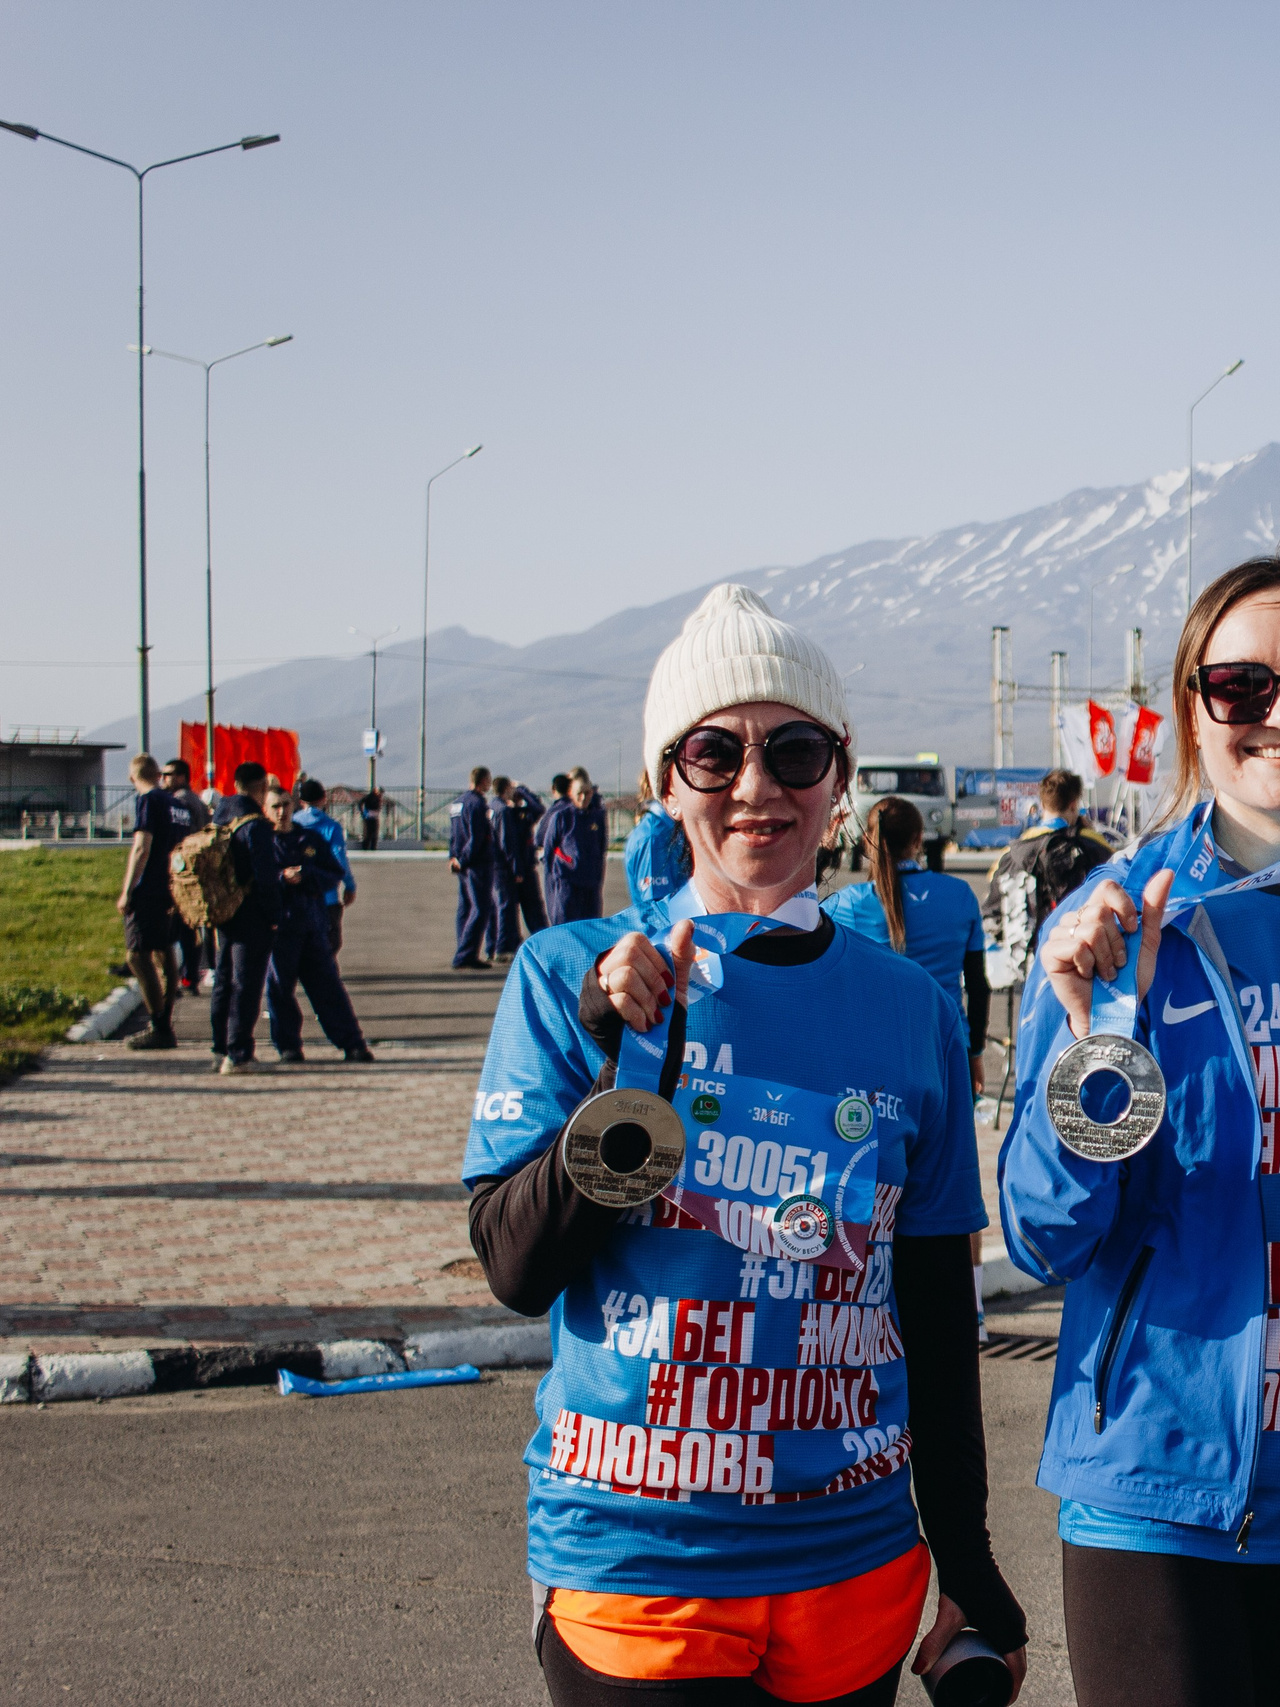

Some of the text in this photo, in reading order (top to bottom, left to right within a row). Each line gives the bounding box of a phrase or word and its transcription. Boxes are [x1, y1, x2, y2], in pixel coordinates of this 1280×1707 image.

[1189, 849, 1214, 882] ПСБ
[692, 1078, 726, 1096] ПСБ
[694, 1130, 829, 1200] 30051
[780, 1195, 801, 1211] WEIGHT
[802, 1195, 818, 1204] LOSS
[808, 1203, 828, 1235] ВЫЗОВ
[778, 1224, 802, 1254] ЛИШНЕМУ
[602, 1289, 756, 1364] #ЗАБЕГ
[646, 1362, 881, 1431] #ГОРДОСТЬ
[549, 1408, 775, 1494] #ЛЮБОВЬ
